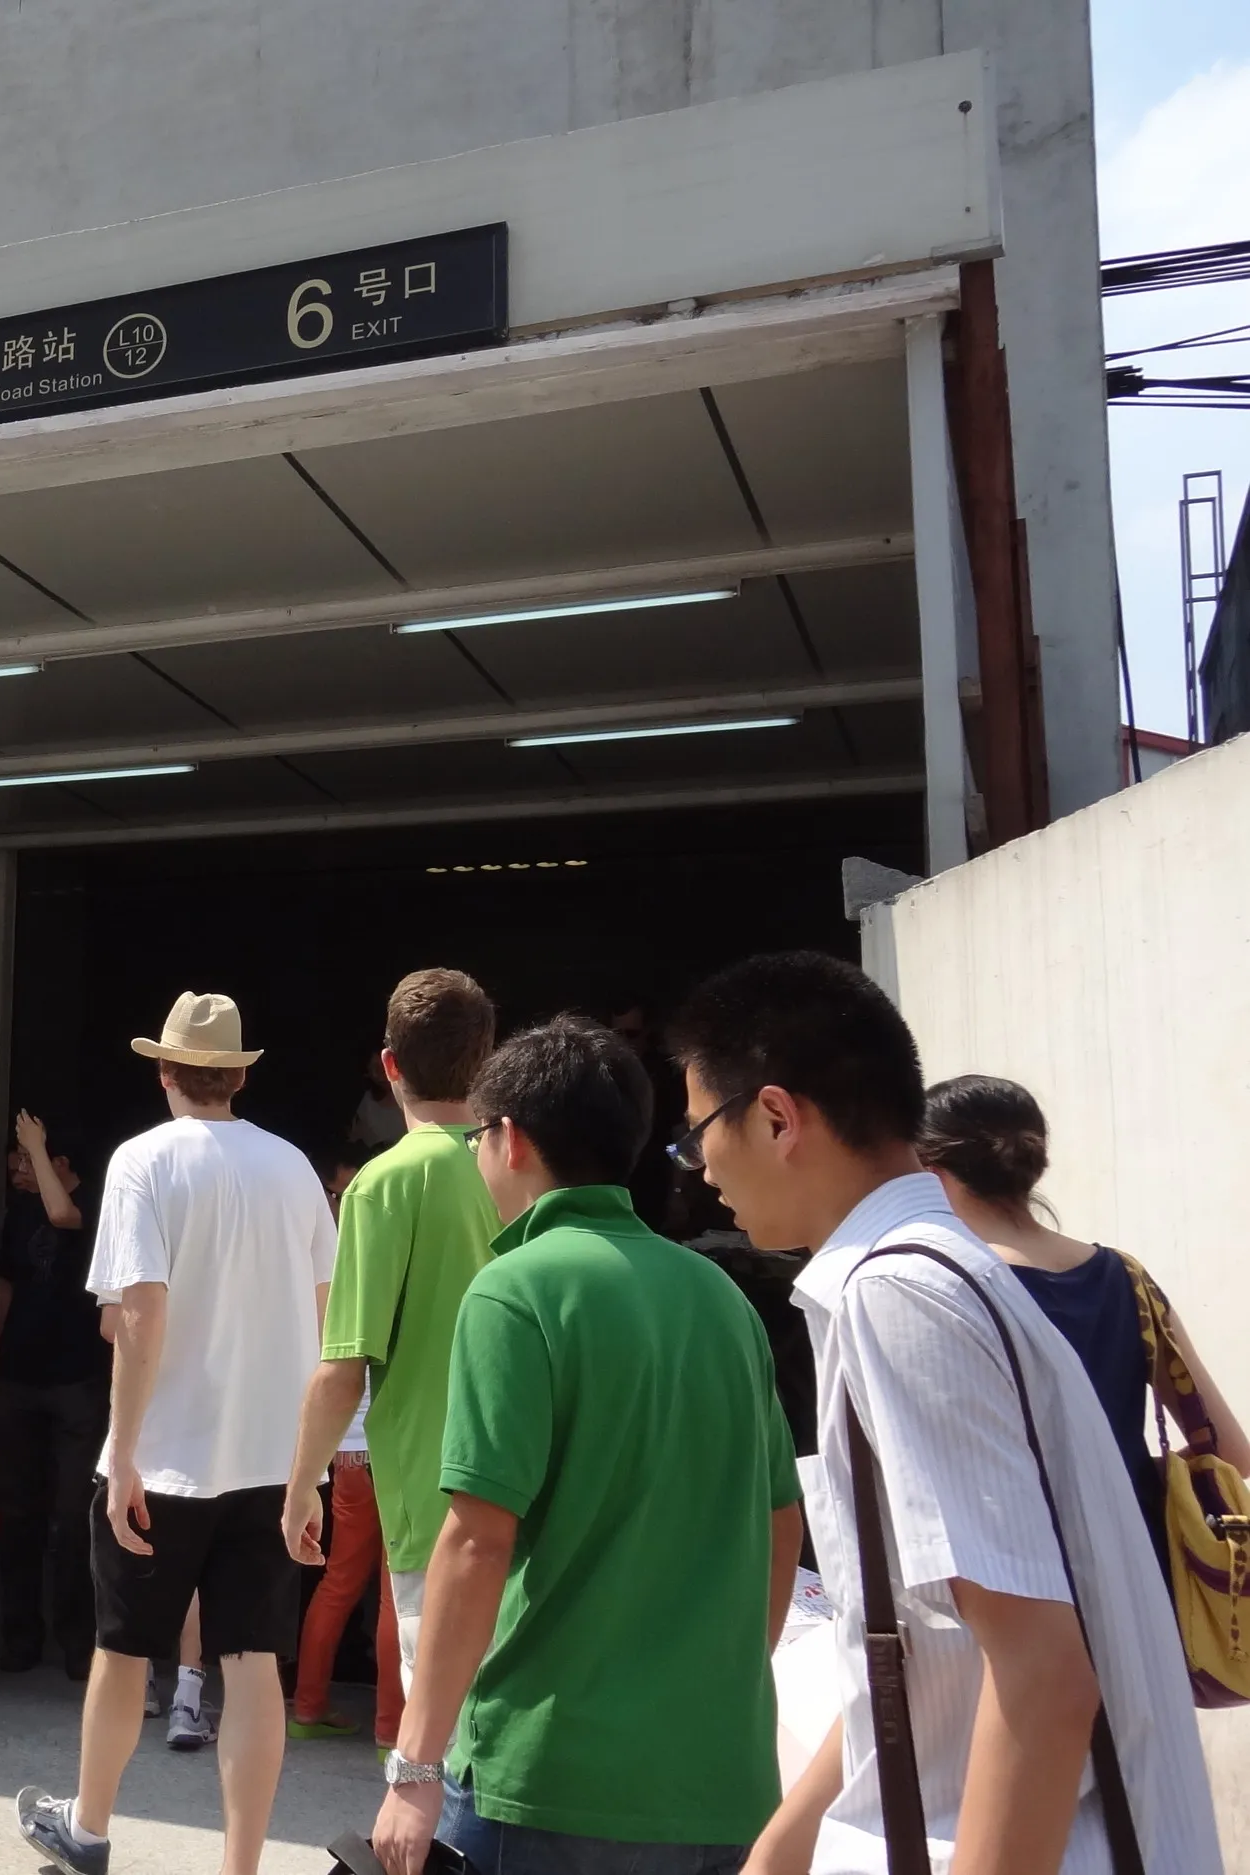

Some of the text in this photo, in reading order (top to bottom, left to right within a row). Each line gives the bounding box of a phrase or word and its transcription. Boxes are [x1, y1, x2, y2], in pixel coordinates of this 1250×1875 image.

[353, 261, 437, 307] 号口
[287, 278, 334, 349] 6
[118, 324, 155, 347] L10
[352, 316, 403, 340] EXIT
[124, 346, 147, 367] 12
[38, 372, 103, 396] Station
